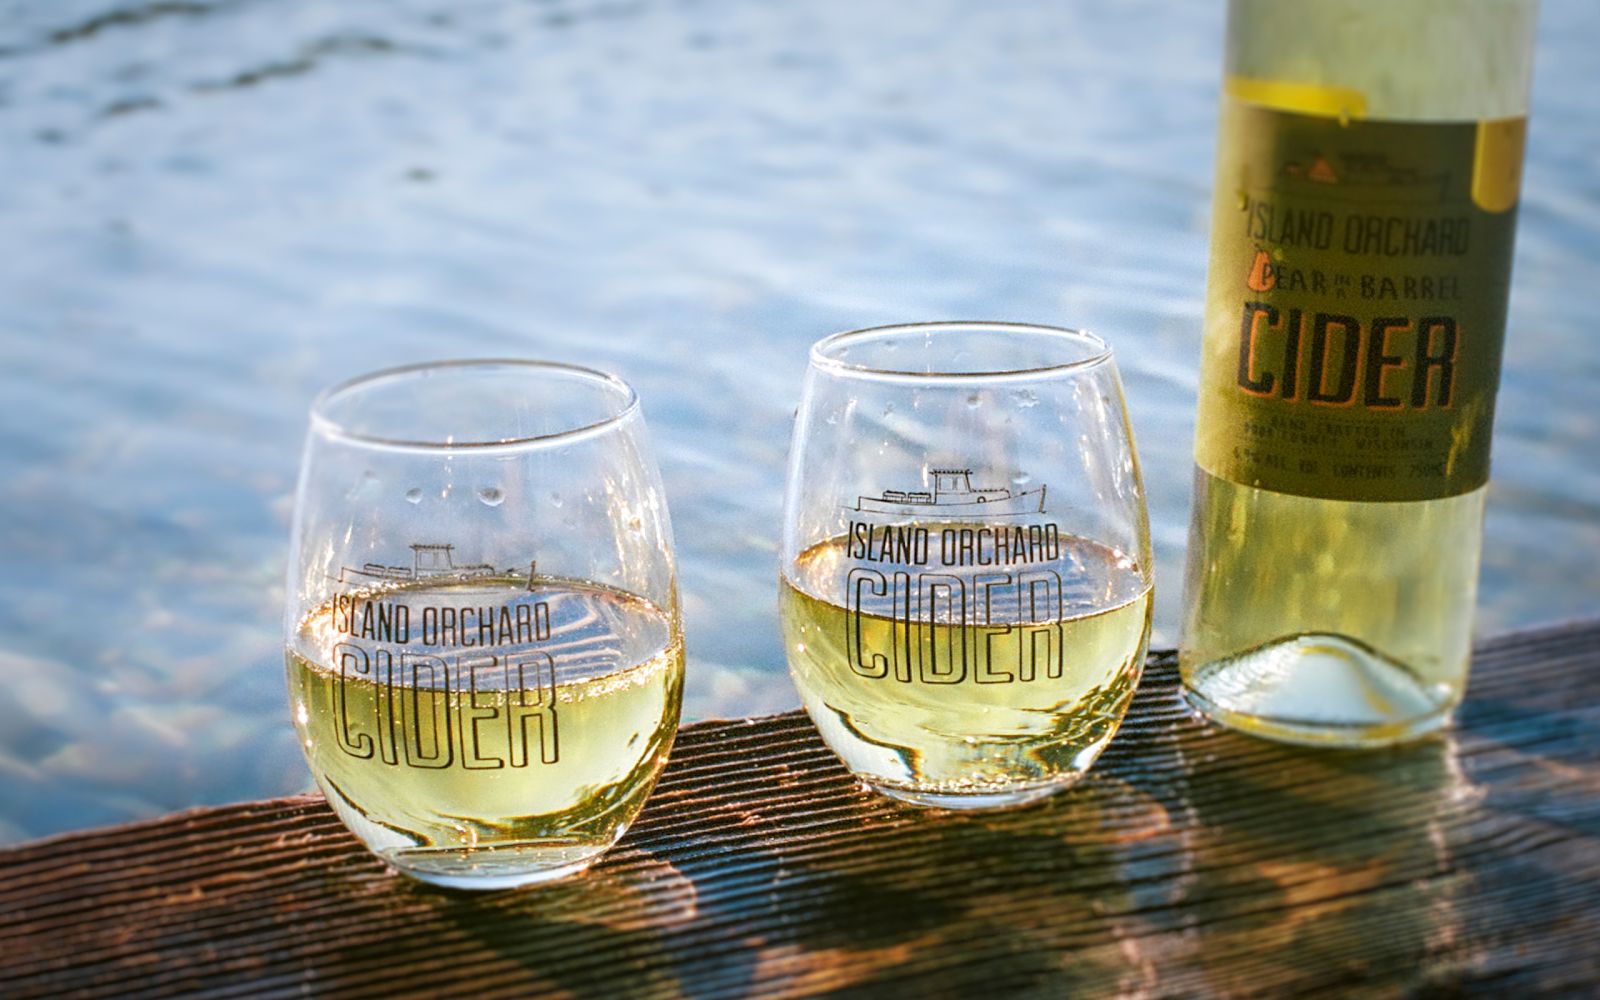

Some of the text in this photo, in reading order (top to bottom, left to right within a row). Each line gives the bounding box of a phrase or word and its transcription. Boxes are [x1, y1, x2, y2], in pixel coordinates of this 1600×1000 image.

[1246, 201, 1472, 257] ISLAND ORCHARD
[1261, 262, 1327, 296] PEAR
[1360, 273, 1459, 301] BARREL
[1238, 301, 1461, 413] CIDER
[846, 520, 1060, 567] ISLAND ORCHARD
[332, 592, 551, 648] ISLAND ORCHARD
[846, 567, 1064, 685] CIDER
[331, 642, 560, 770] CIDER
